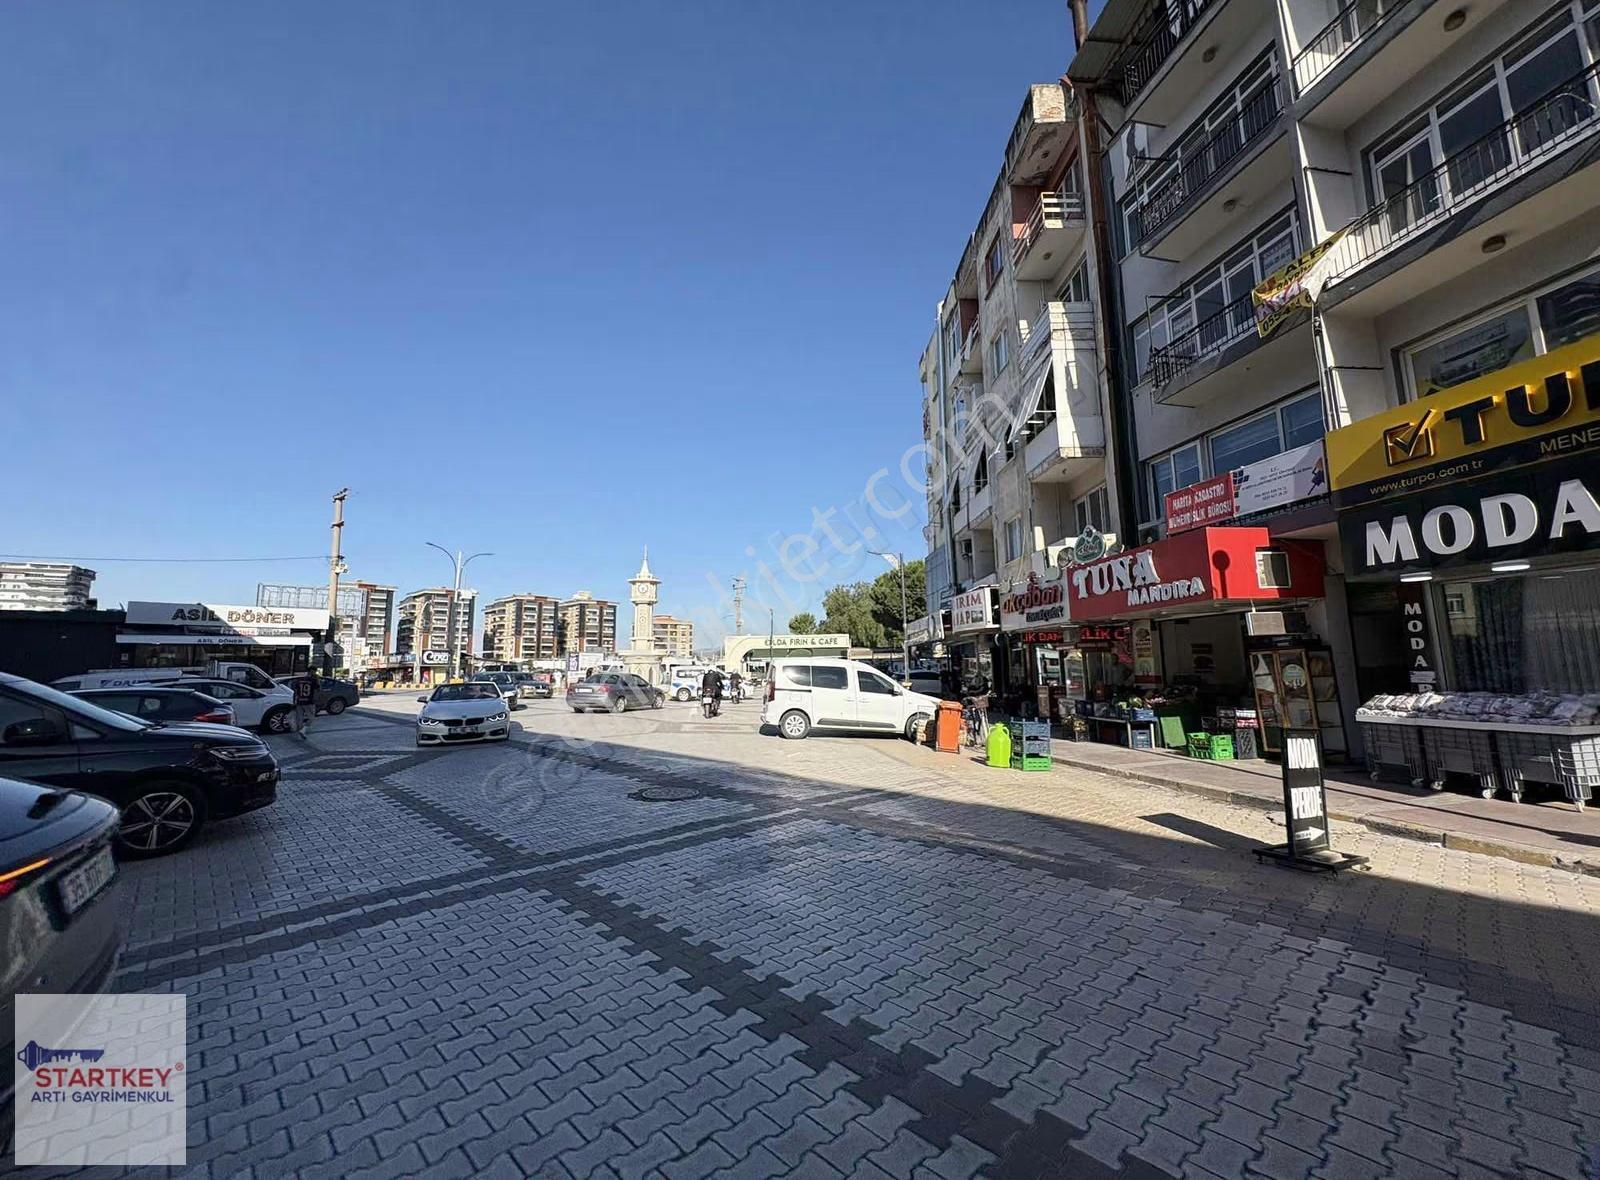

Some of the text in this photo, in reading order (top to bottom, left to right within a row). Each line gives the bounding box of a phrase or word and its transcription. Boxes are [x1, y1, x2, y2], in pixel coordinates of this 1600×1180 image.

[1366, 478, 1600, 567] MODA
[1072, 549, 1161, 599] TUNA
[1127, 576, 1206, 607] MANDIRA
[227, 609, 295, 625] DÖNER
[1404, 602, 1428, 668] MODA
[1286, 737, 1320, 770] MODA
[1290, 785, 1324, 820] PERDE
